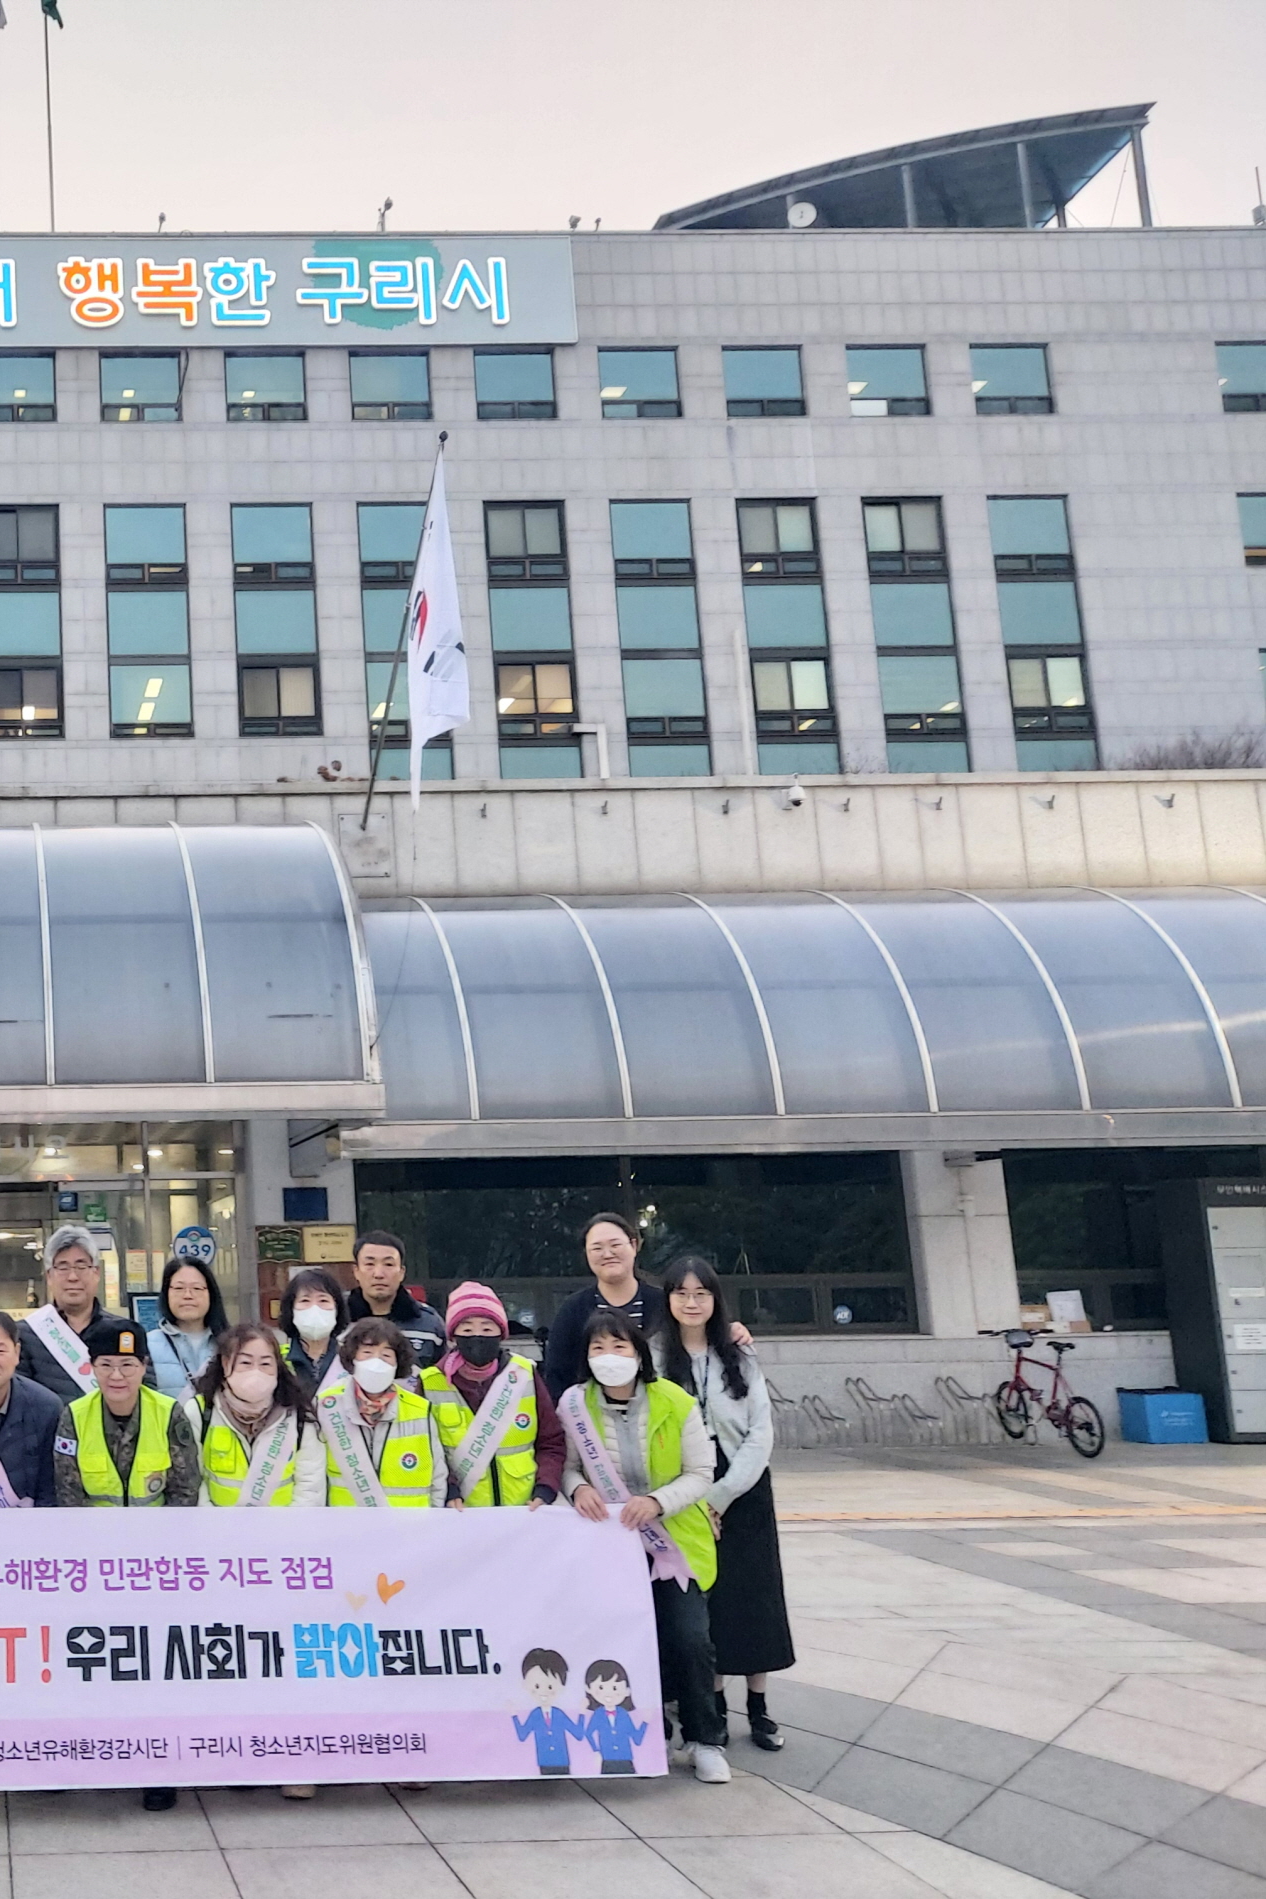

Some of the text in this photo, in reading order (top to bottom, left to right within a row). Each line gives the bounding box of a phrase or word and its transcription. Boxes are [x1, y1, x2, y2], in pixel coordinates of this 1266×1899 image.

[56, 256, 276, 327] 행복한
[296, 256, 512, 327] 구리시
[178, 1243, 212, 1257] 439
[492, 1387, 514, 1422] 건강한
[328, 1412, 352, 1451] 건강한
[345, 1453, 371, 1494] 청소년
[469, 1419, 498, 1459] 청소년
[251, 1457, 277, 1502] 청소년
[99, 1556, 210, 1592] 민관합동
[218, 1557, 274, 1588] 지도
[280, 1556, 335, 1590] 점검
[65, 1625, 150, 1683] 우리
[163, 1623, 285, 1682] 사회가
[292, 1621, 502, 1679] 밝아집니다.
[188, 1732, 428, 1758] 구리시 청소년지도위원협의회
